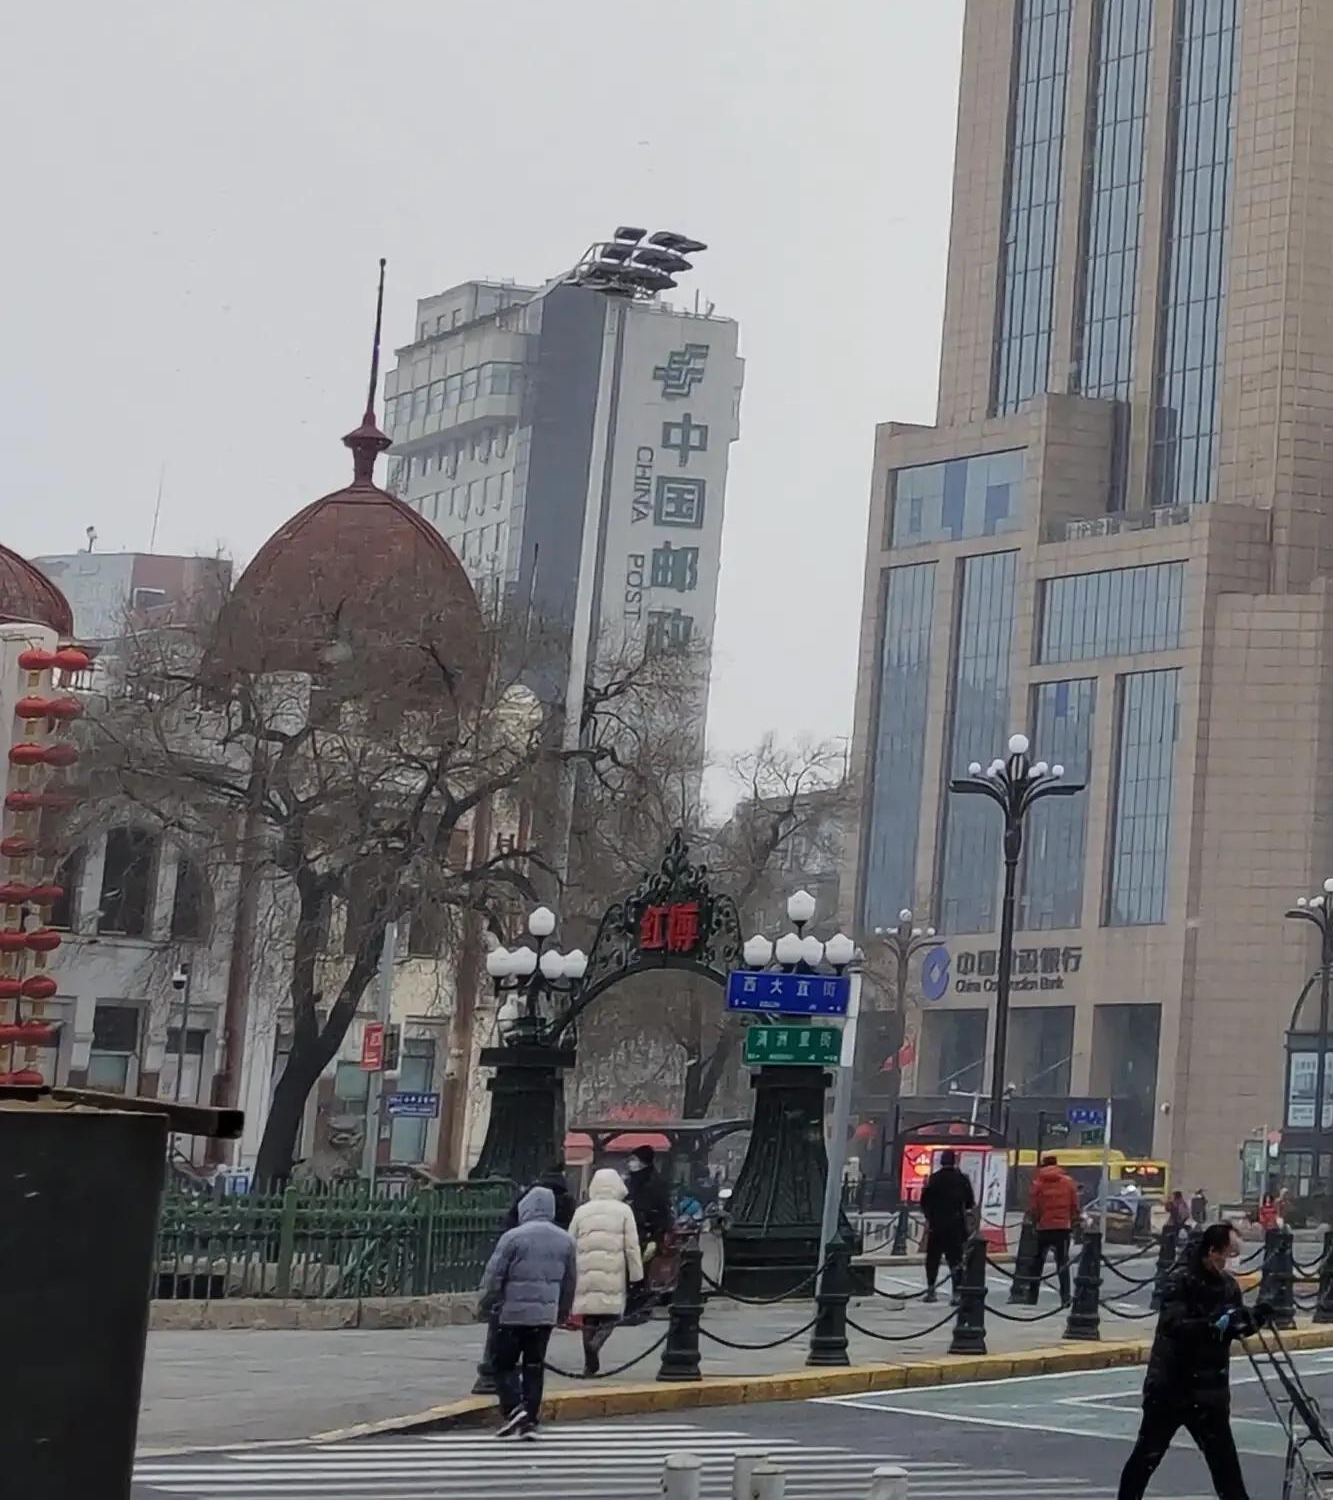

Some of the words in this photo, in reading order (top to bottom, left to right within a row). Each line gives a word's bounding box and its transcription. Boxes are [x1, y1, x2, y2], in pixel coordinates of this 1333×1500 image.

[631, 446, 654, 524] CHINA
[624, 553, 645, 620] POST
[957, 946, 1083, 976] 中国设银行
[744, 976, 837, 998] 西大直街
